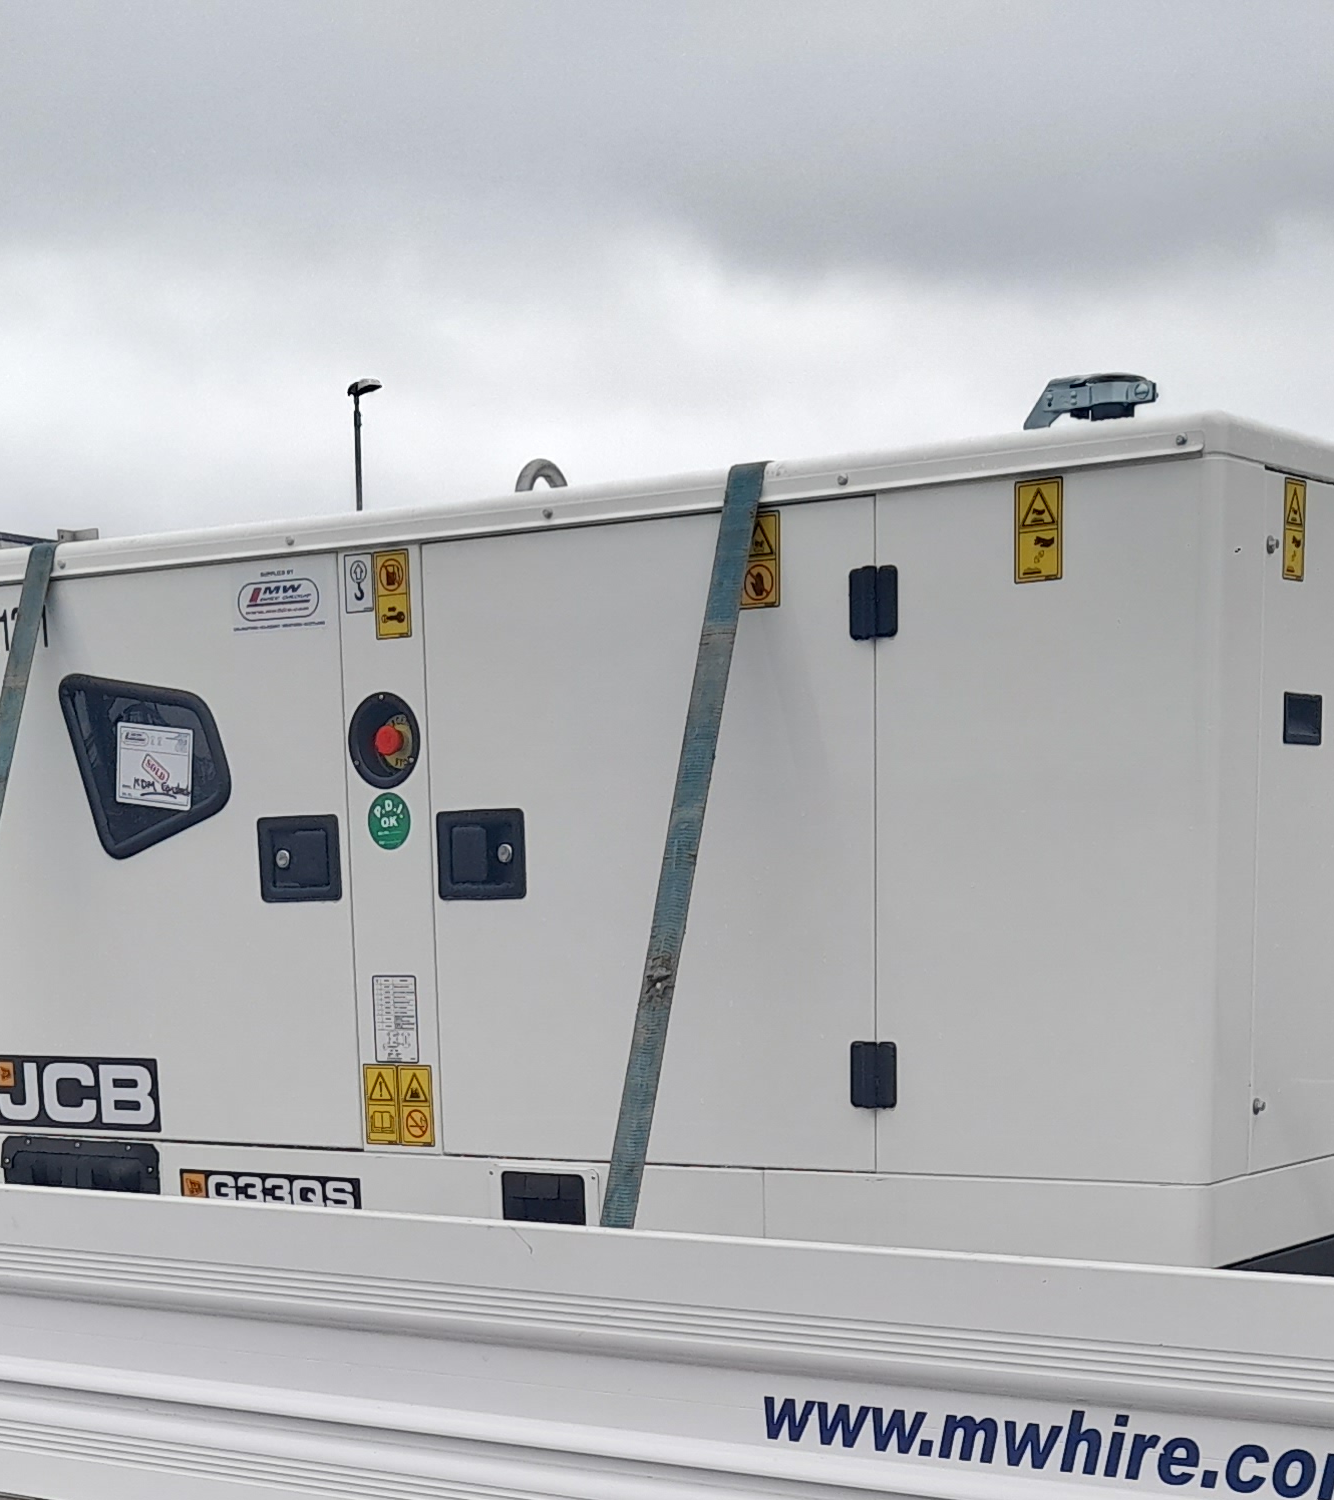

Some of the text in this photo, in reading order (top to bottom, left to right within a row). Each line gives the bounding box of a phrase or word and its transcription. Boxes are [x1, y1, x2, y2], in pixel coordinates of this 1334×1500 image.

[263, 583, 302, 595] MW
[145, 758, 166, 781] SOLD
[373, 800, 404, 818] P.D.I.
[381, 816, 398, 828] OK
[208, 1174, 355, 1209] G33QS
